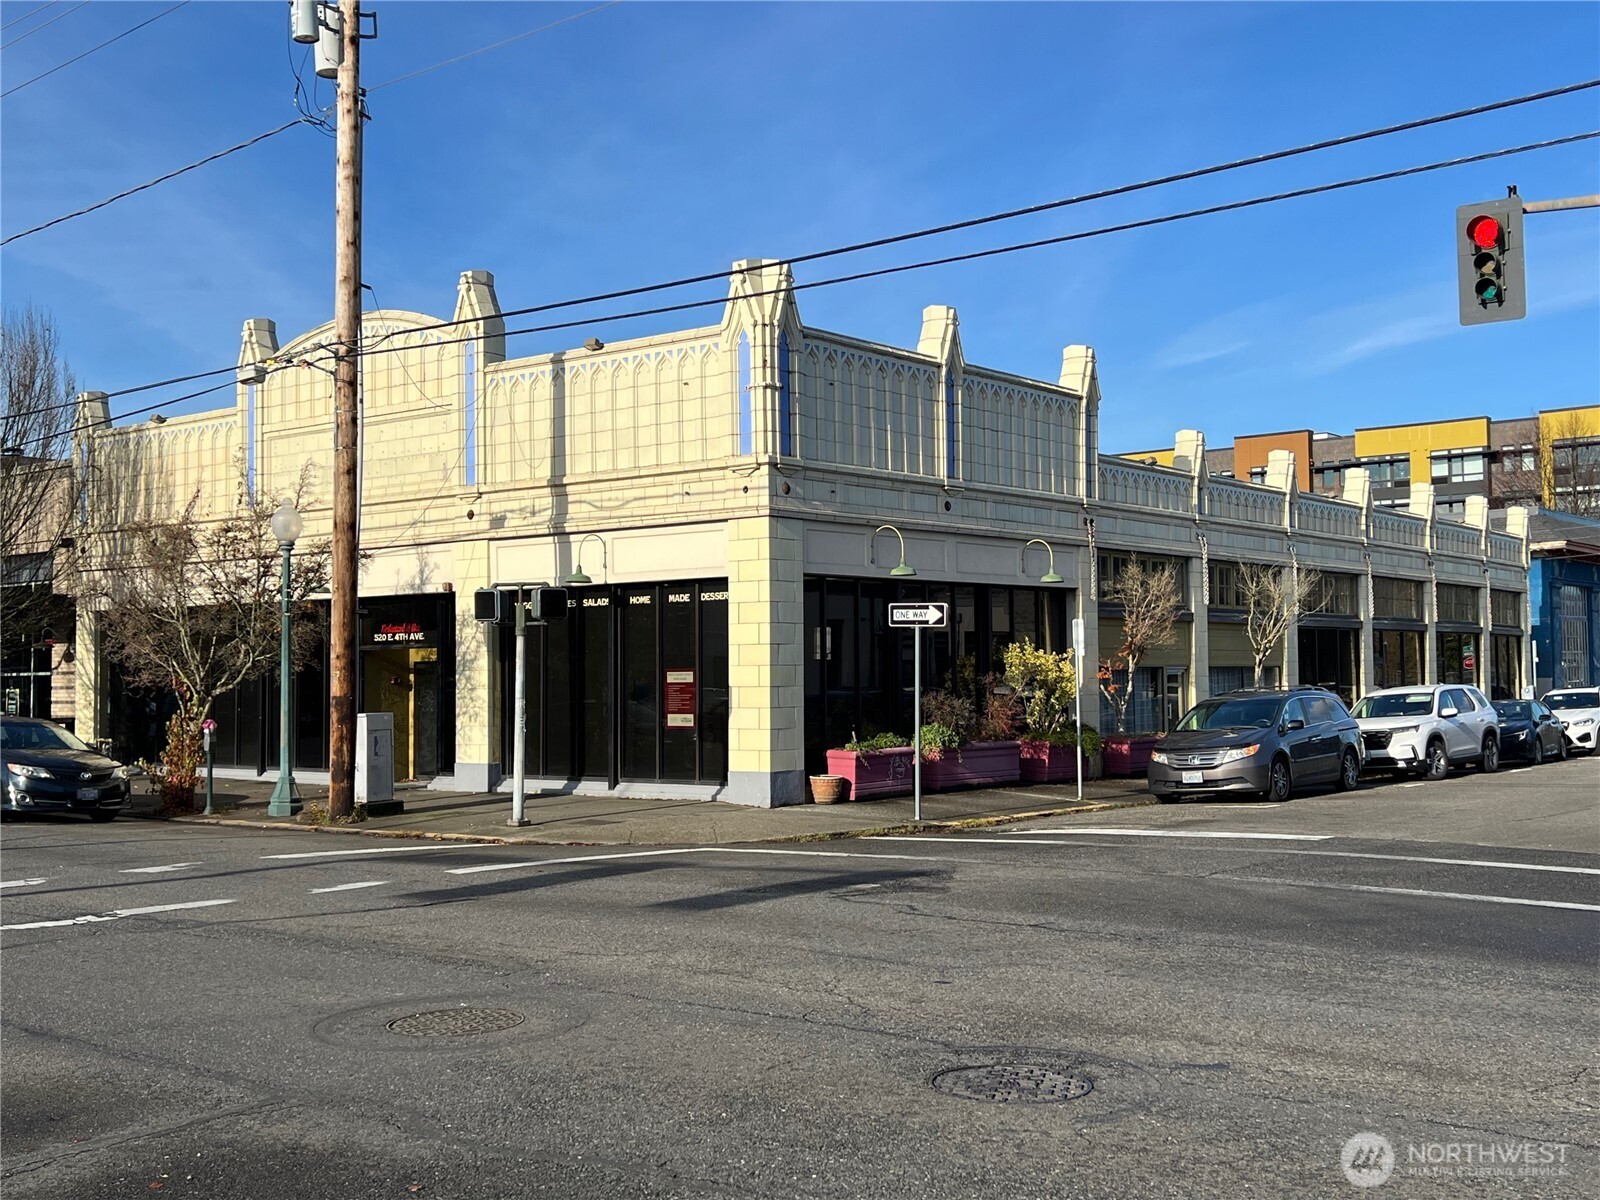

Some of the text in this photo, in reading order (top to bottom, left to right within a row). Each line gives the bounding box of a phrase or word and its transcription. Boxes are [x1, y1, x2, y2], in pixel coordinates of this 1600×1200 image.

[629, 595, 651, 604] HOME
[668, 593, 691, 603] MADE
[700, 591, 728, 601] DESSER
[895, 610, 928, 619] ONE WAY
[373, 633, 387, 641] 520
[394, 632, 408, 641] 4TH
